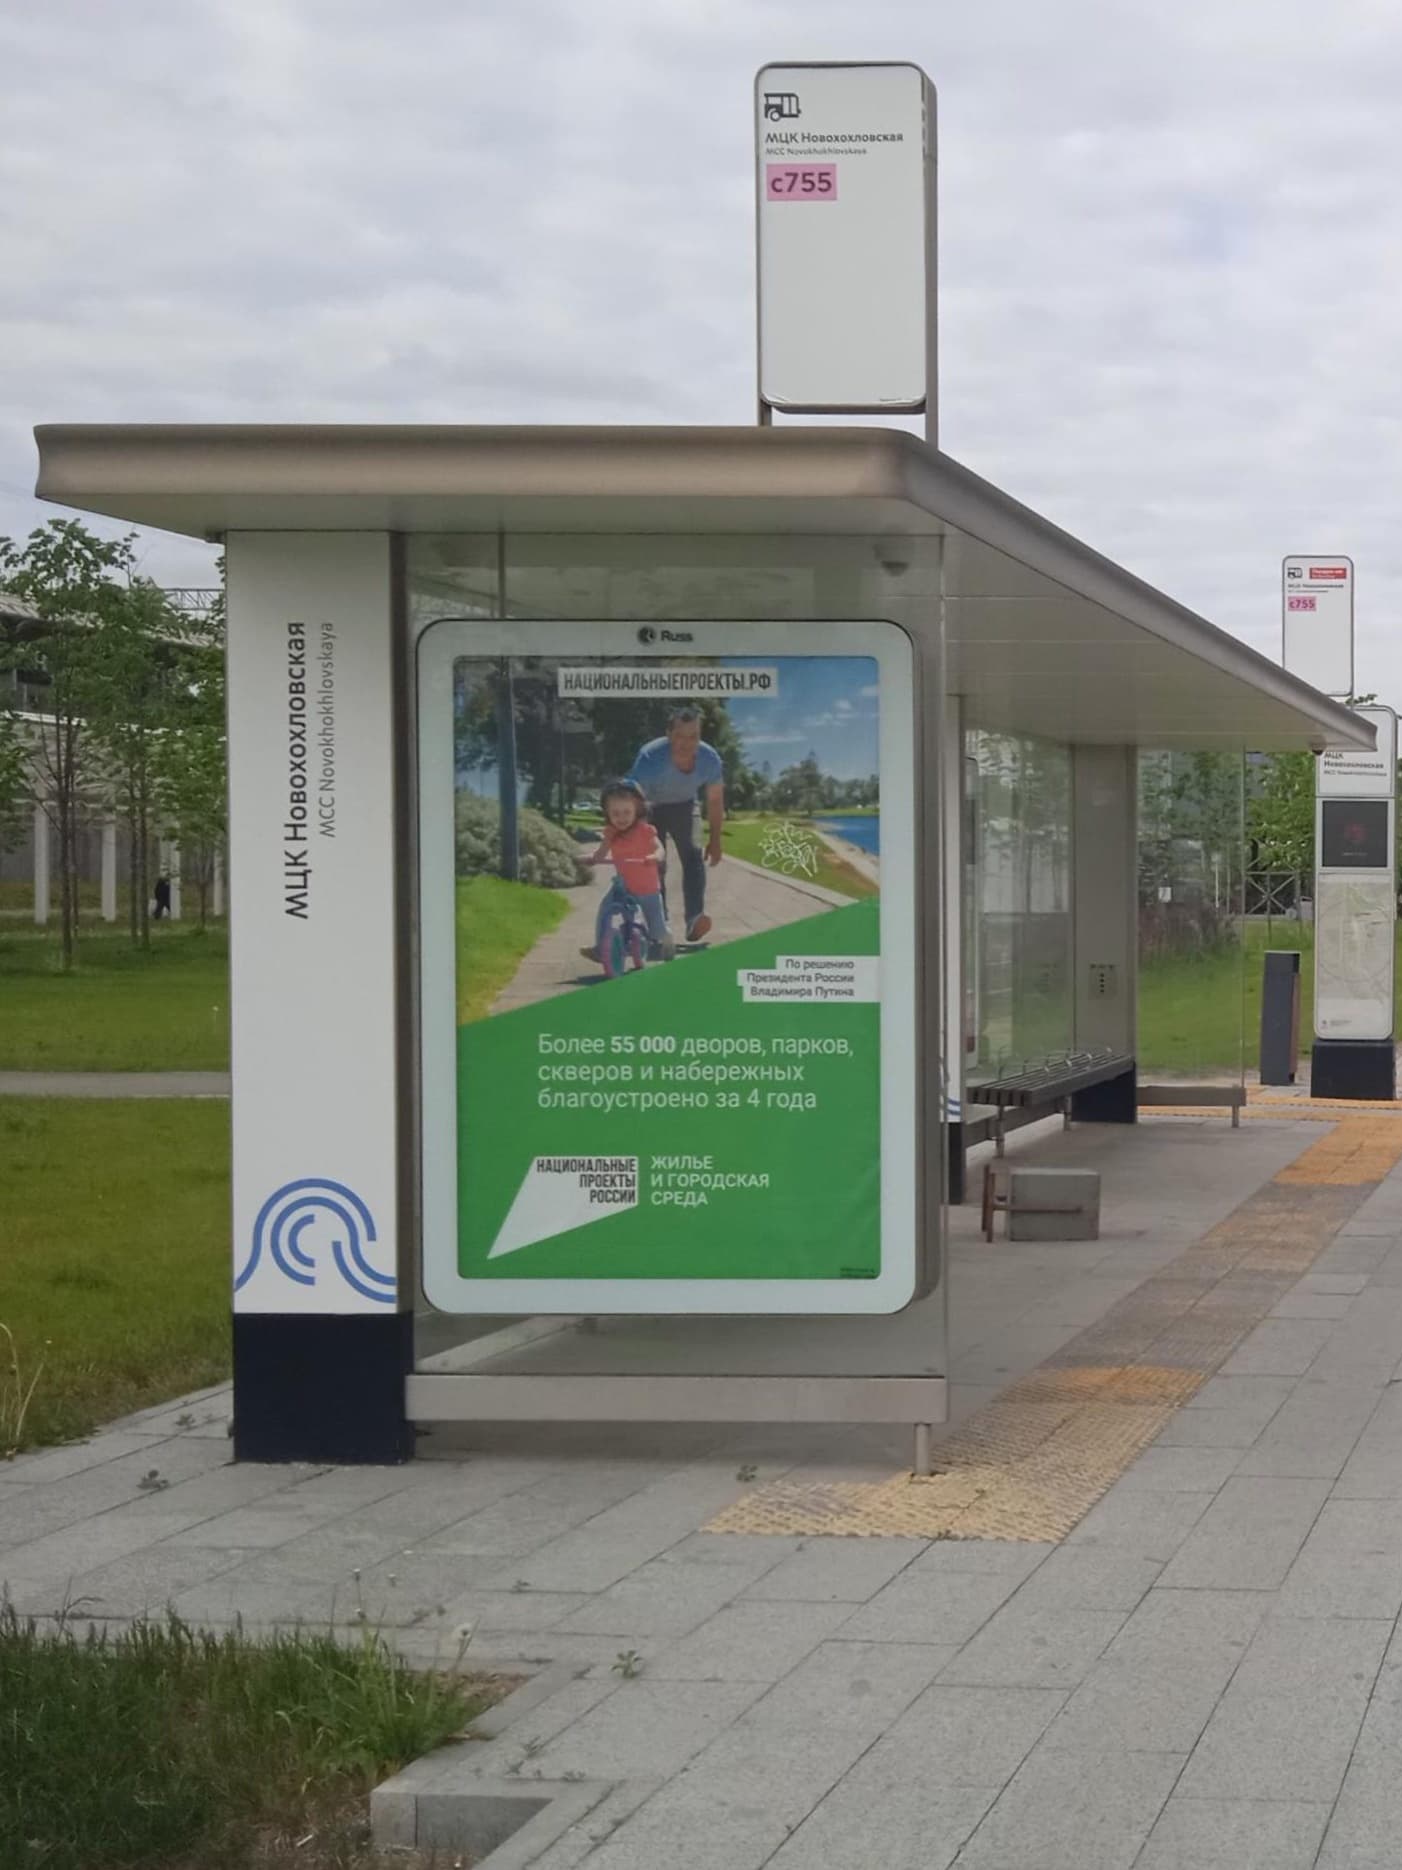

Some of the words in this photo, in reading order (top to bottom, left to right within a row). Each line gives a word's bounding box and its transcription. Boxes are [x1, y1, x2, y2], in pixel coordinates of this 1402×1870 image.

[764, 132, 798, 144] МЦК
[801, 132, 904, 143] Новохохловская
[771, 172, 832, 193] с755
[660, 630, 694, 643] Russ
[564, 672, 772, 692] НАЦИОНАЛЬНЫЕПРОЕКТЫ.РФ
[316, 621, 338, 792] Novokhokhlovskaya
[284, 621, 308, 842] Новохохловская
[318, 796, 337, 839] MCC
[284, 849, 313, 920] МЦК
[786, 958, 801, 969] По
[803, 960, 855, 970] решению
[747, 972, 812, 983] Президента
[815, 972, 855, 983] России
[750, 986, 812, 997] Владимира
[815, 986, 855, 998] Путина
[538, 1032, 605, 1054] Более
[610, 1036, 635, 1053] 55
[639, 1036, 677, 1053] 000
[681, 1036, 767, 1059] дворов,
[771, 1037, 854, 1059] парков,
[537, 1064, 633, 1086] скверов
[640, 1064, 654, 1081] и
[660, 1059, 805, 1086] набережных
[537, 1087, 709, 1113] благоустроено
[715, 1091, 740, 1108] за
[747, 1087, 761, 1108] 4
[767, 1091, 817, 1112] года
[536, 1158, 636, 1175] НАЦИОНАЛЬНЫЕ
[650, 1156, 713, 1170] ЖИЛЬЕ
[579, 1174, 636, 1188] ПРОЕКТЫ
[651, 1173, 663, 1187] И
[667, 1173, 770, 1190] ГОРОДСКАЯ
[589, 1189, 636, 1204] РОССИИ
[651, 1191, 709, 1208] СРЕДА
